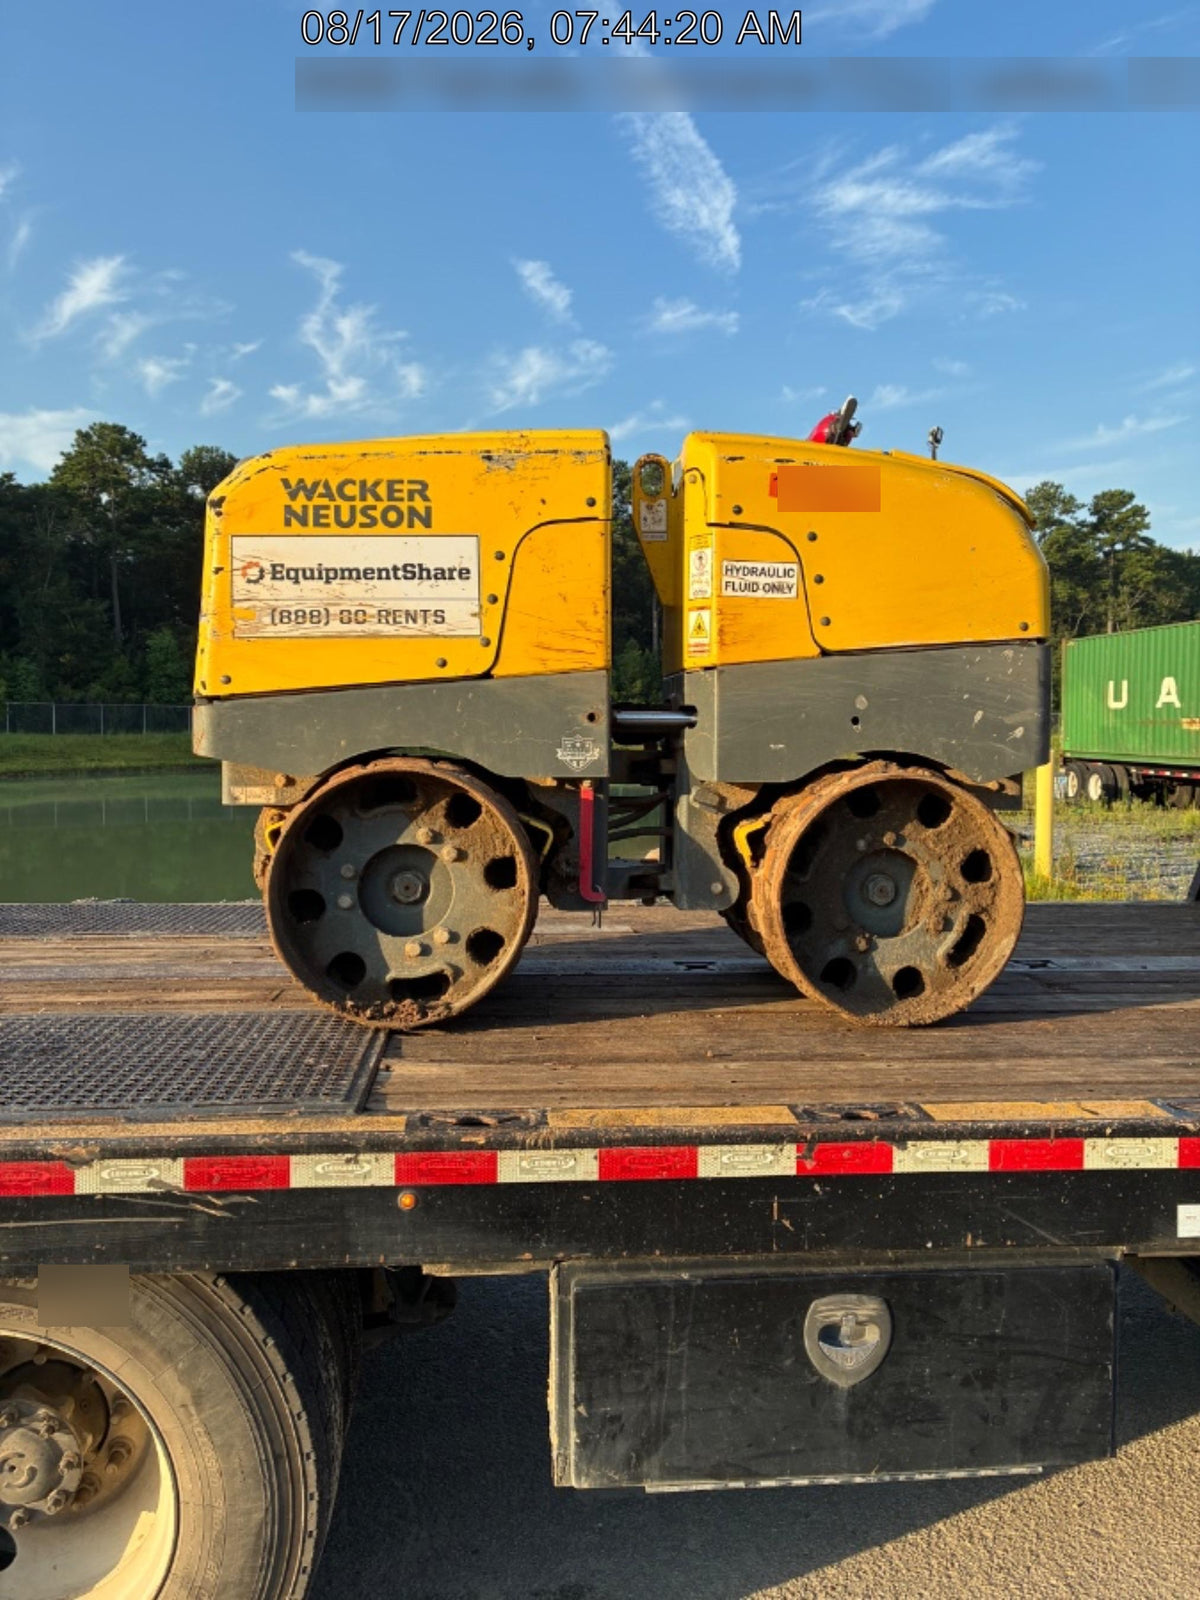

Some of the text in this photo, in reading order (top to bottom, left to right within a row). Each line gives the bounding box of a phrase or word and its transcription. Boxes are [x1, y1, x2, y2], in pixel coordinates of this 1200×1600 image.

[281, 478, 432, 502] WACKER
[284, 504, 432, 529] NEUSON
[270, 563, 471, 584] EquipmentShare
[725, 565, 796, 578] HYDRAULIC
[725, 581, 795, 595] FLUID ONLY
[271, 609, 330, 626] (888)
